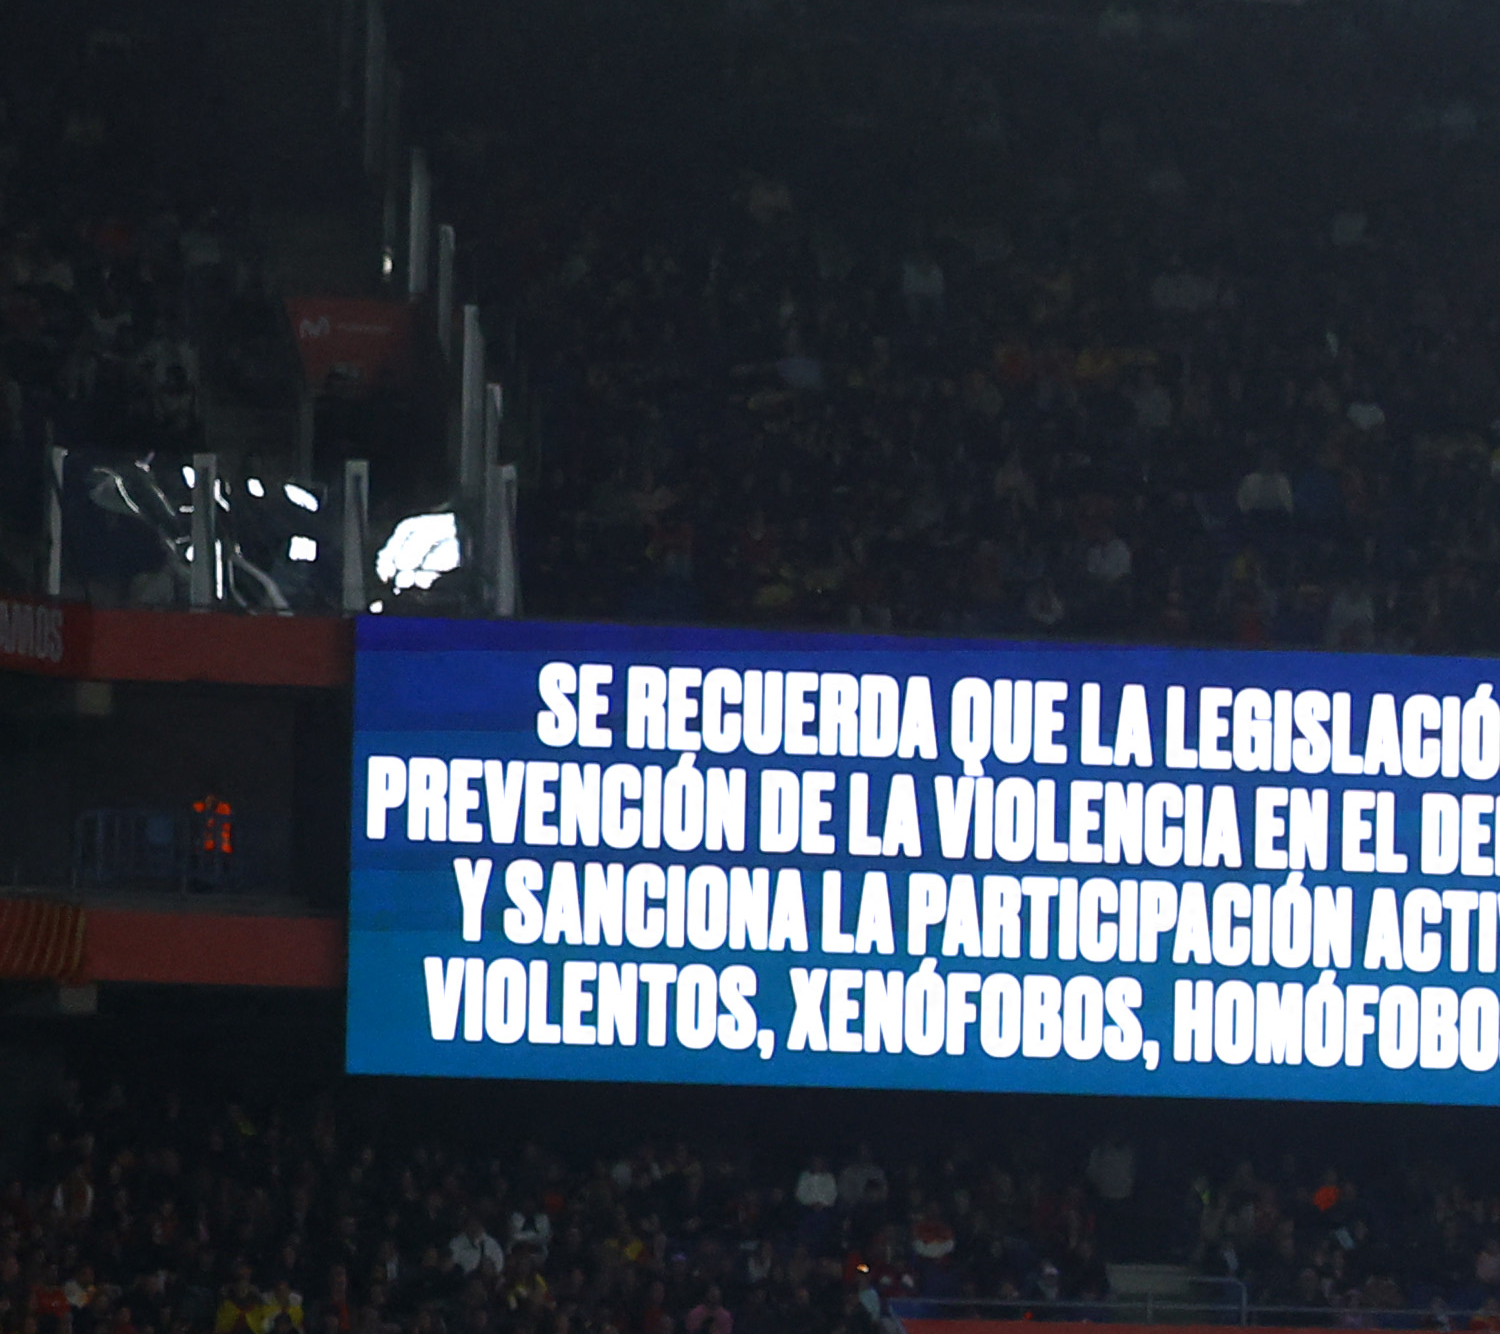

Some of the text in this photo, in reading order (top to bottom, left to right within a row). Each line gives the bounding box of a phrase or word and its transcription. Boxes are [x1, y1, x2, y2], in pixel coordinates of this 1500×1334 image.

[538, 663, 612, 747] SE
[627, 666, 937, 759] RECUERDA
[951, 679, 1067, 775] QUE
[1081, 683, 1152, 766] LA
[367, 752, 746, 851] PREVENCIÓN
[760, 770, 835, 854] DE
[849, 773, 921, 857] LA
[935, 774, 1242, 867] VIOLENCIA
[1255, 787, 1328, 870] EN
[1342, 790, 1407, 873] EL
[453, 858, 493, 942] Y
[503, 859, 808, 952] SANCIONA
[823, 870, 894, 954] LA
[907, 872, 1352, 969] PARTICIPACIÓN
[424, 957, 774, 1059] VIOLENTOS,
[787, 958, 1159, 1070] XENÓFOBOS,
